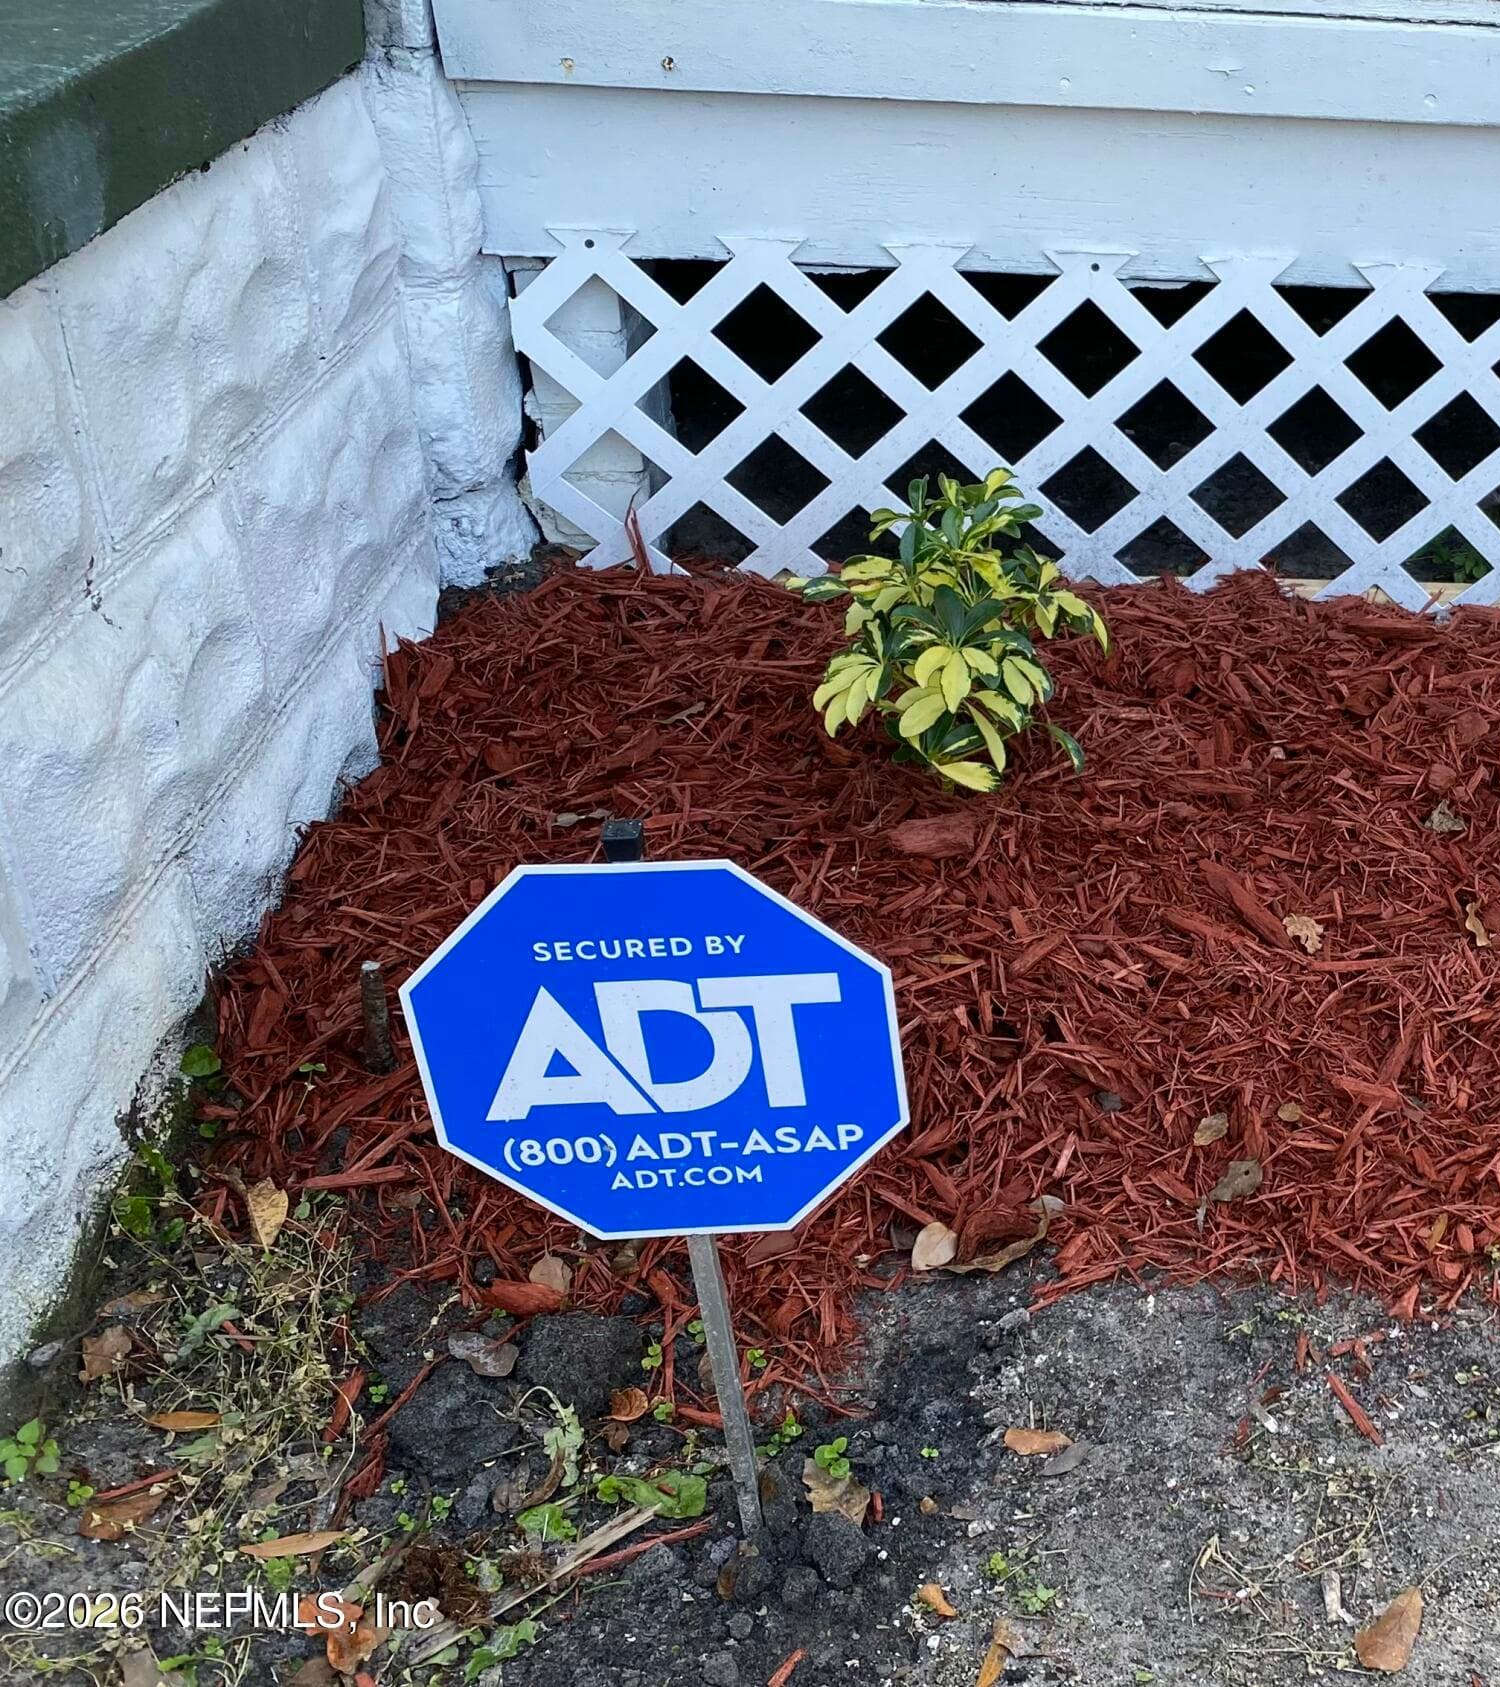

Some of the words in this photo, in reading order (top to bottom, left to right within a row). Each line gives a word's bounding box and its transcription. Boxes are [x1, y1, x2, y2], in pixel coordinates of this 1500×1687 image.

[533, 937, 692, 961] SECURED
[705, 934, 745, 954] BY
[485, 973, 841, 1121] ADT
[503, 1134, 617, 1171] (800)
[627, 1124, 864, 1161] ADT-ASAP
[611, 1165, 762, 1190] ADT.COM
